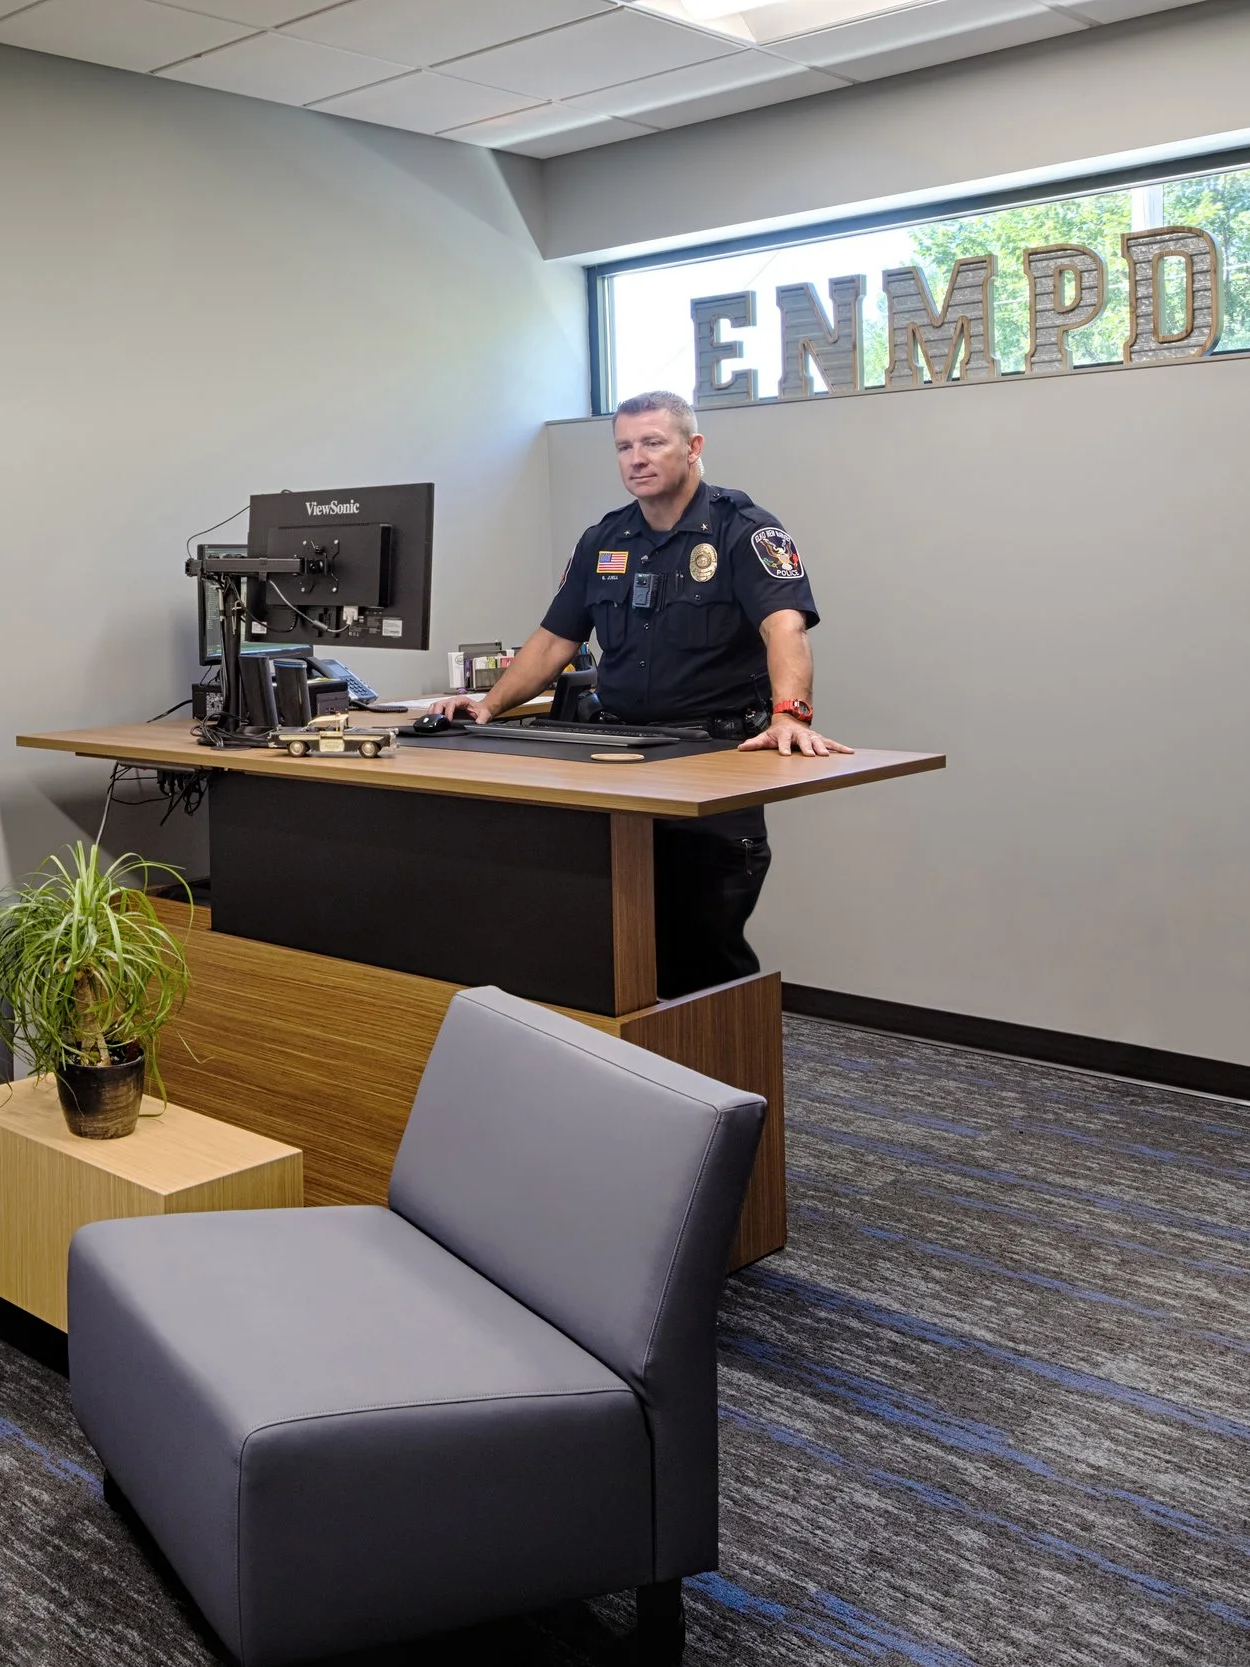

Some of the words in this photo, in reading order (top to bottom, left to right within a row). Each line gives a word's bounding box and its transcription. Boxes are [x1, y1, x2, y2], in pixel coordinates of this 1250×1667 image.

[690, 226, 1225, 406] ENMPD
[305, 499, 360, 516] ViewSonic
[776, 569, 800, 577] POLICE
